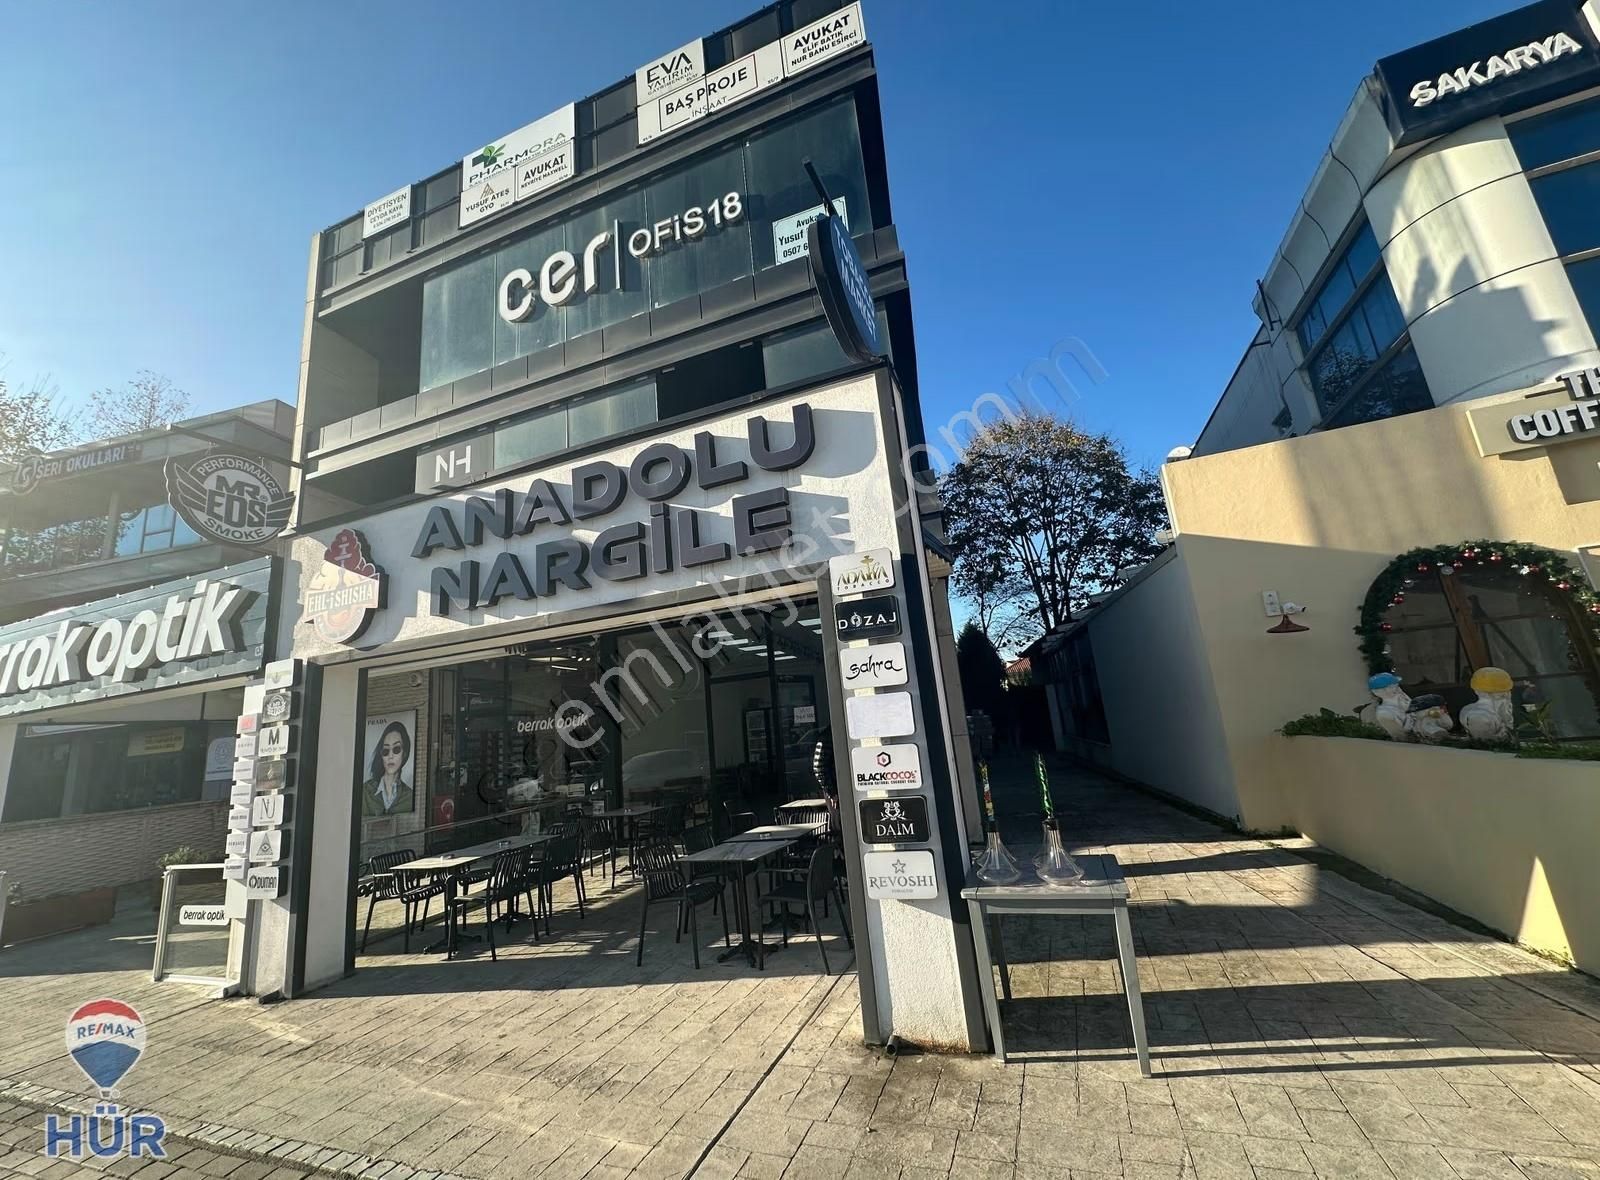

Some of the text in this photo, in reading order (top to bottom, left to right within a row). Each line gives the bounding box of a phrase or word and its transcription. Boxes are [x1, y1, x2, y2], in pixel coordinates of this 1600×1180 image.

[793, 14, 850, 51] AVUKAT
[820, 30, 843, 45] BATIK
[647, 52, 692, 84] EVA
[791, 54, 807, 66] NUR
[809, 44, 830, 58] BANU
[1409, 32, 1583, 107] SAKARYA
[469, 132, 566, 183] PHARMORA
[523, 154, 566, 181] AVUKAT
[465, 196, 489, 212] YUSUF
[479, 202, 494, 213] GYO
[778, 230, 804, 246] Yusuf
[783, 245, 801, 258] 0507
[500, 231, 612, 322] cer
[707, 191, 742, 227] 18
[1511, 400, 1600, 441] COFF
[435, 445, 471, 482] NH
[196, 459, 280, 496] PERFORMANCE
[411, 403, 815, 557] ANADOLU
[204, 517, 266, 540] SMOKE
[86, 579, 244, 684] optik
[846, 655, 903, 681] sahra
[517, 717, 554, 732] berrak
[183, 909, 225, 921] berrak optik
